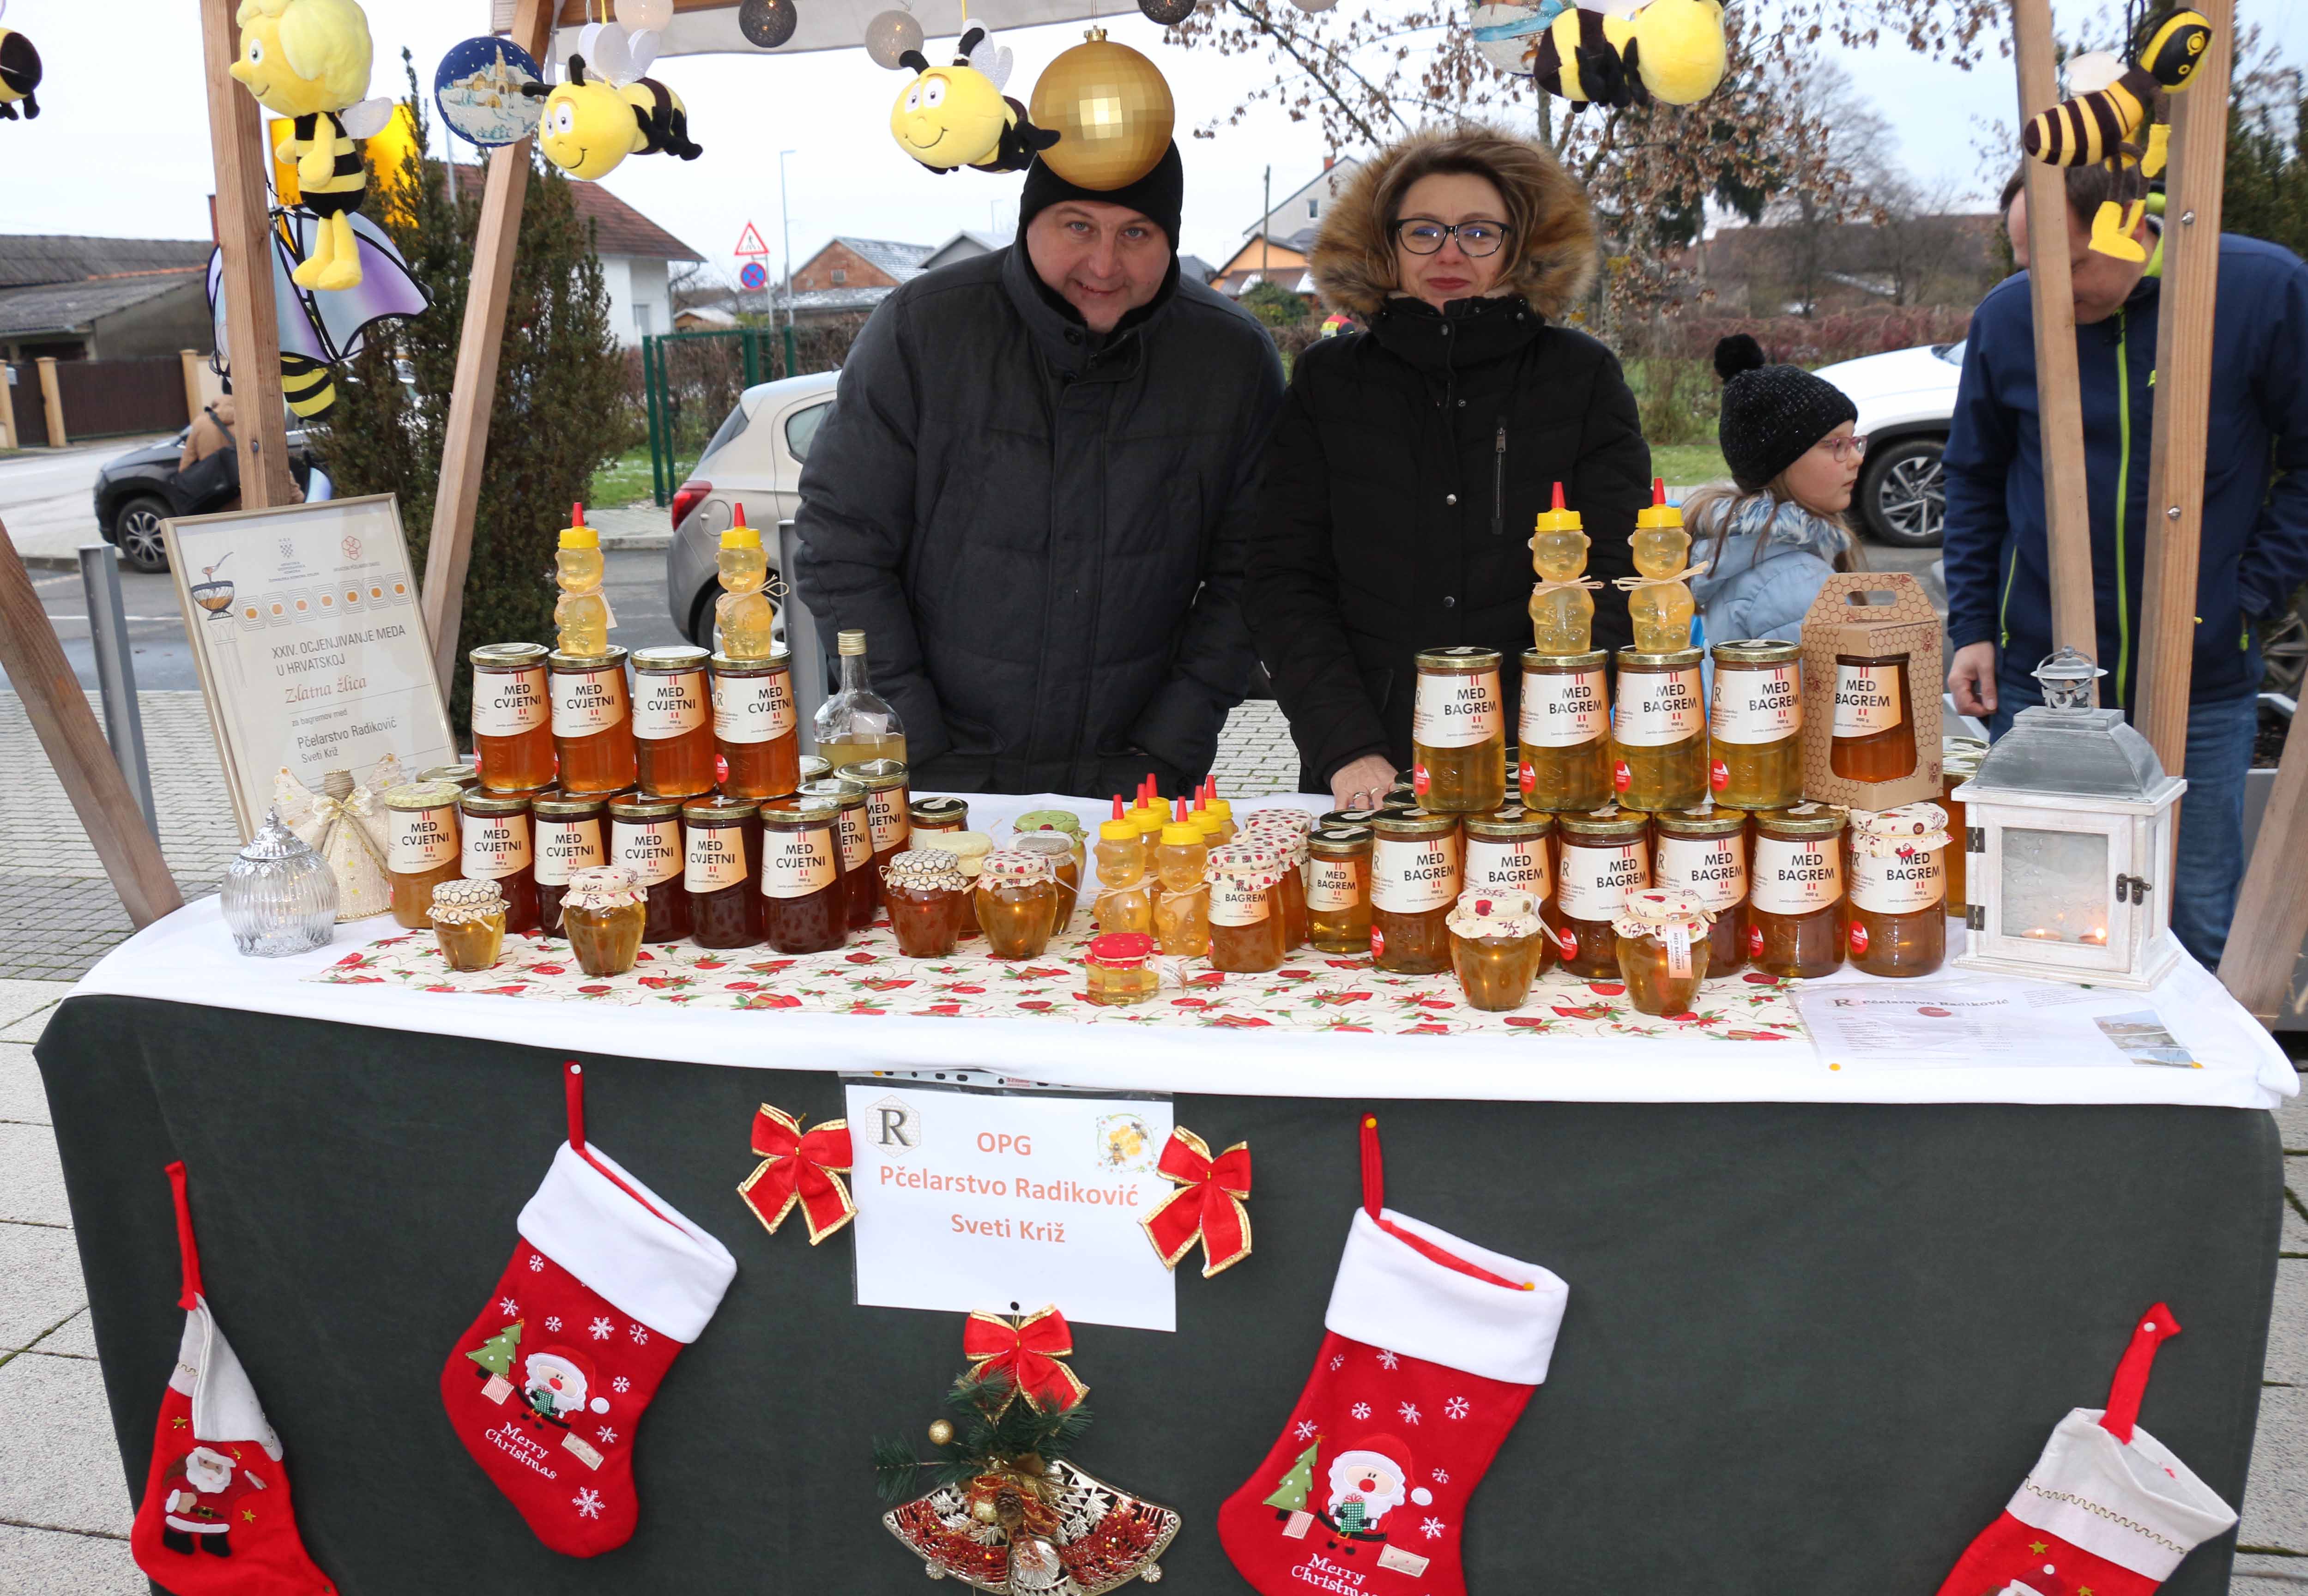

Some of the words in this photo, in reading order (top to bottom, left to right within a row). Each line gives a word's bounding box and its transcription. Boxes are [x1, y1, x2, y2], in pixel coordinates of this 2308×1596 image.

[272, 645, 298, 659] XXIV.
[300, 630, 375, 653] OCJENJIVANJE
[376, 625, 405, 640] MEDA
[277, 665, 284, 676] U
[287, 653, 345, 674] HRVATSKOJ
[285, 684, 332, 704] Zlatna
[337, 675, 367, 693] žlica
[504, 684, 530, 695] MED
[576, 685, 602, 695] MED
[657, 687, 684, 697] MED
[1656, 684, 1685, 696] MED
[1762, 682, 1789, 695] MED
[1846, 680, 1876, 691] MED
[759, 687, 782, 699] MED
[1457, 688, 1486, 700] MED
[1562, 687, 1591, 698] MED
[1714, 687, 1721, 702] R
[495, 695, 541, 708] CVJETNI
[567, 695, 614, 709] CVJETNI
[647, 699, 695, 710] CVJETNI
[717, 693, 723, 706] R
[748, 698, 791, 713] CVJETNI
[1643, 698, 1697, 712] BAGREM
[1749, 695, 1799, 711] BAGREM
[1836, 693, 1890, 707] BAGREM
[1444, 701, 1496, 715] BAGREM
[1550, 700, 1602, 714] BAGREM
[334, 709, 347, 719] med
[297, 730, 349, 749] Pčelarstvo
[351, 717, 397, 736] Radiković
[302, 752, 322, 763] Sveti
[324, 747, 338, 758] Križ
[869, 814, 900, 826] JETNI
[411, 822, 437, 832] MED
[842, 822, 855, 832] ED
[402, 833, 449, 845] CVJETNI
[483, 829, 510, 839] MED
[556, 834, 581, 843] MED
[843, 833, 864, 845] ETNI
[474, 841, 521, 851] CVJETNI
[635, 836, 661, 846] MED
[698, 841, 722, 850] MED
[547, 846, 593, 857] CVJETNI
[626, 847, 673, 858] CVJETNI
[786, 844, 813, 854] MED
[690, 853, 735, 863] CVJETNI
[777, 856, 825, 868] CVJETNI
[1374, 855, 1379, 870] R
[1417, 853, 1444, 865] MED
[1501, 856, 1531, 867] MED
[1658, 854, 1664, 869] R
[1705, 853, 1733, 865] MED
[1792, 855, 1823, 865] MED
[1853, 852, 1860, 867] R
[1901, 853, 1930, 865] MED
[1563, 861, 1569, 877] R
[1610, 859, 1637, 872] MED
[1404, 865, 1454, 881] BAGREM
[1489, 868, 1543, 882] BAGREM
[1692, 865, 1742, 881] BAGREM
[1779, 868, 1834, 881] BAGREM
[1887, 865, 1939, 880] BAGREM
[1317, 880, 1355, 889] BAGREM
[1597, 871, 1646, 888] BAGREM
[877, 1108, 912, 1146] R
[976, 1131, 1032, 1155] OPG
[880, 1166, 1007, 1196] Pčelarstvo
[1015, 1178, 1138, 1206] Radiković
[951, 1214, 1011, 1238] Sveti
[1020, 1221, 1065, 1243] Križ
[501, 1421, 549, 1459] Merry
[486, 1429, 557, 1479] Christmas
[1308, 1553, 1366, 1584] Merry
[1292, 1565, 1378, 1596] Christm
